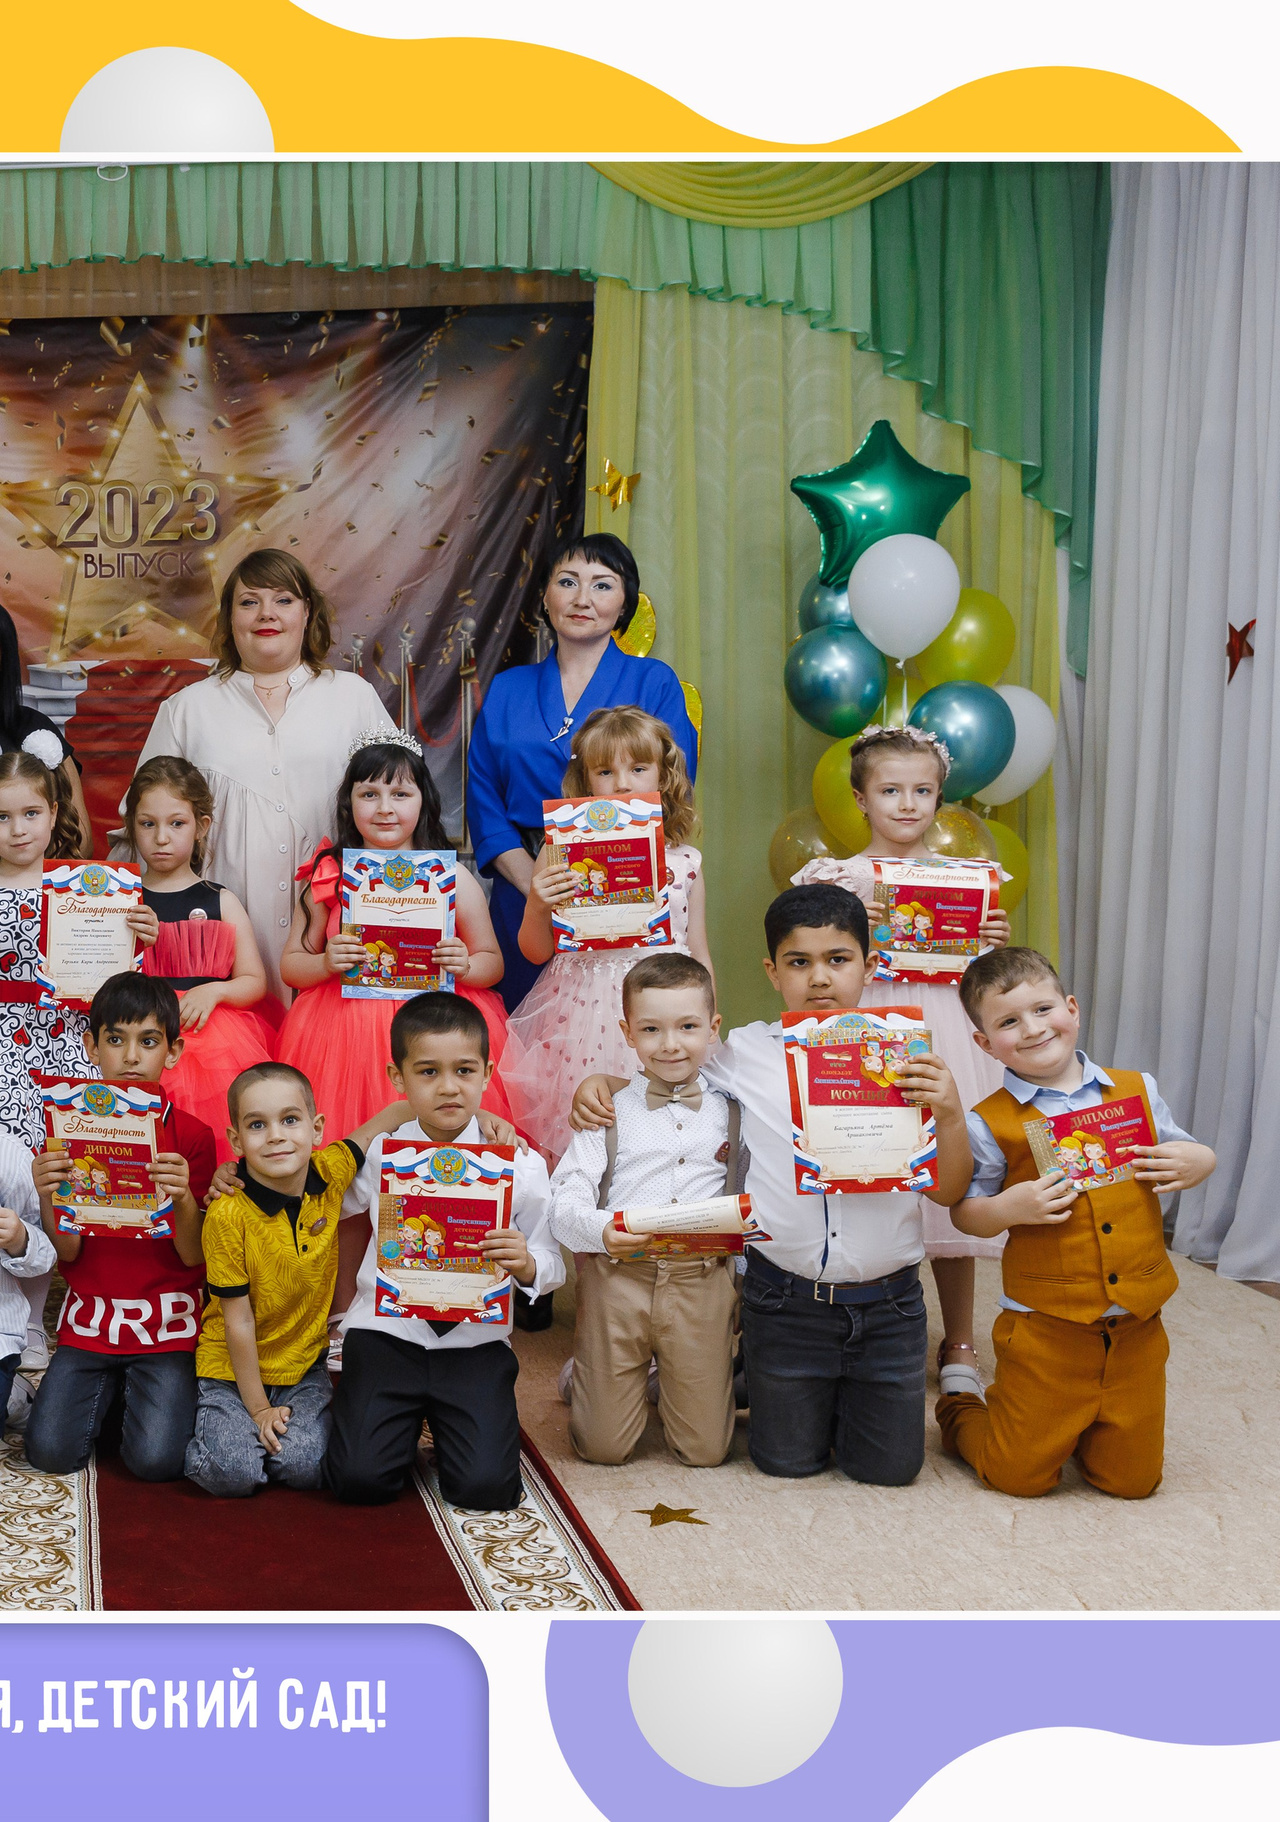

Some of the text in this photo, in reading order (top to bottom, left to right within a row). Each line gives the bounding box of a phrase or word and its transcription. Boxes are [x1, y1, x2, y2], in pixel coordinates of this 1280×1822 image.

[55, 479, 220, 548] 2023
[83, 552, 196, 578] ВЫПУСК
[582, 843, 631, 857] ДИПЛОМ
[893, 866, 980, 884] Благодарность
[57, 896, 132, 917] Благодарность
[361, 893, 437, 907] Благодарность
[830, 1089, 890, 1101] ДИПЛОМ
[63, 1115, 146, 1138] Благодарность
[1070, 1105, 1125, 1129] ДИПЛОМ
[84, 1144, 133, 1156] ДИПЛОМ
[447, 1216, 492, 1226] Выпускнику
[56, 1286, 204, 1345] URB
